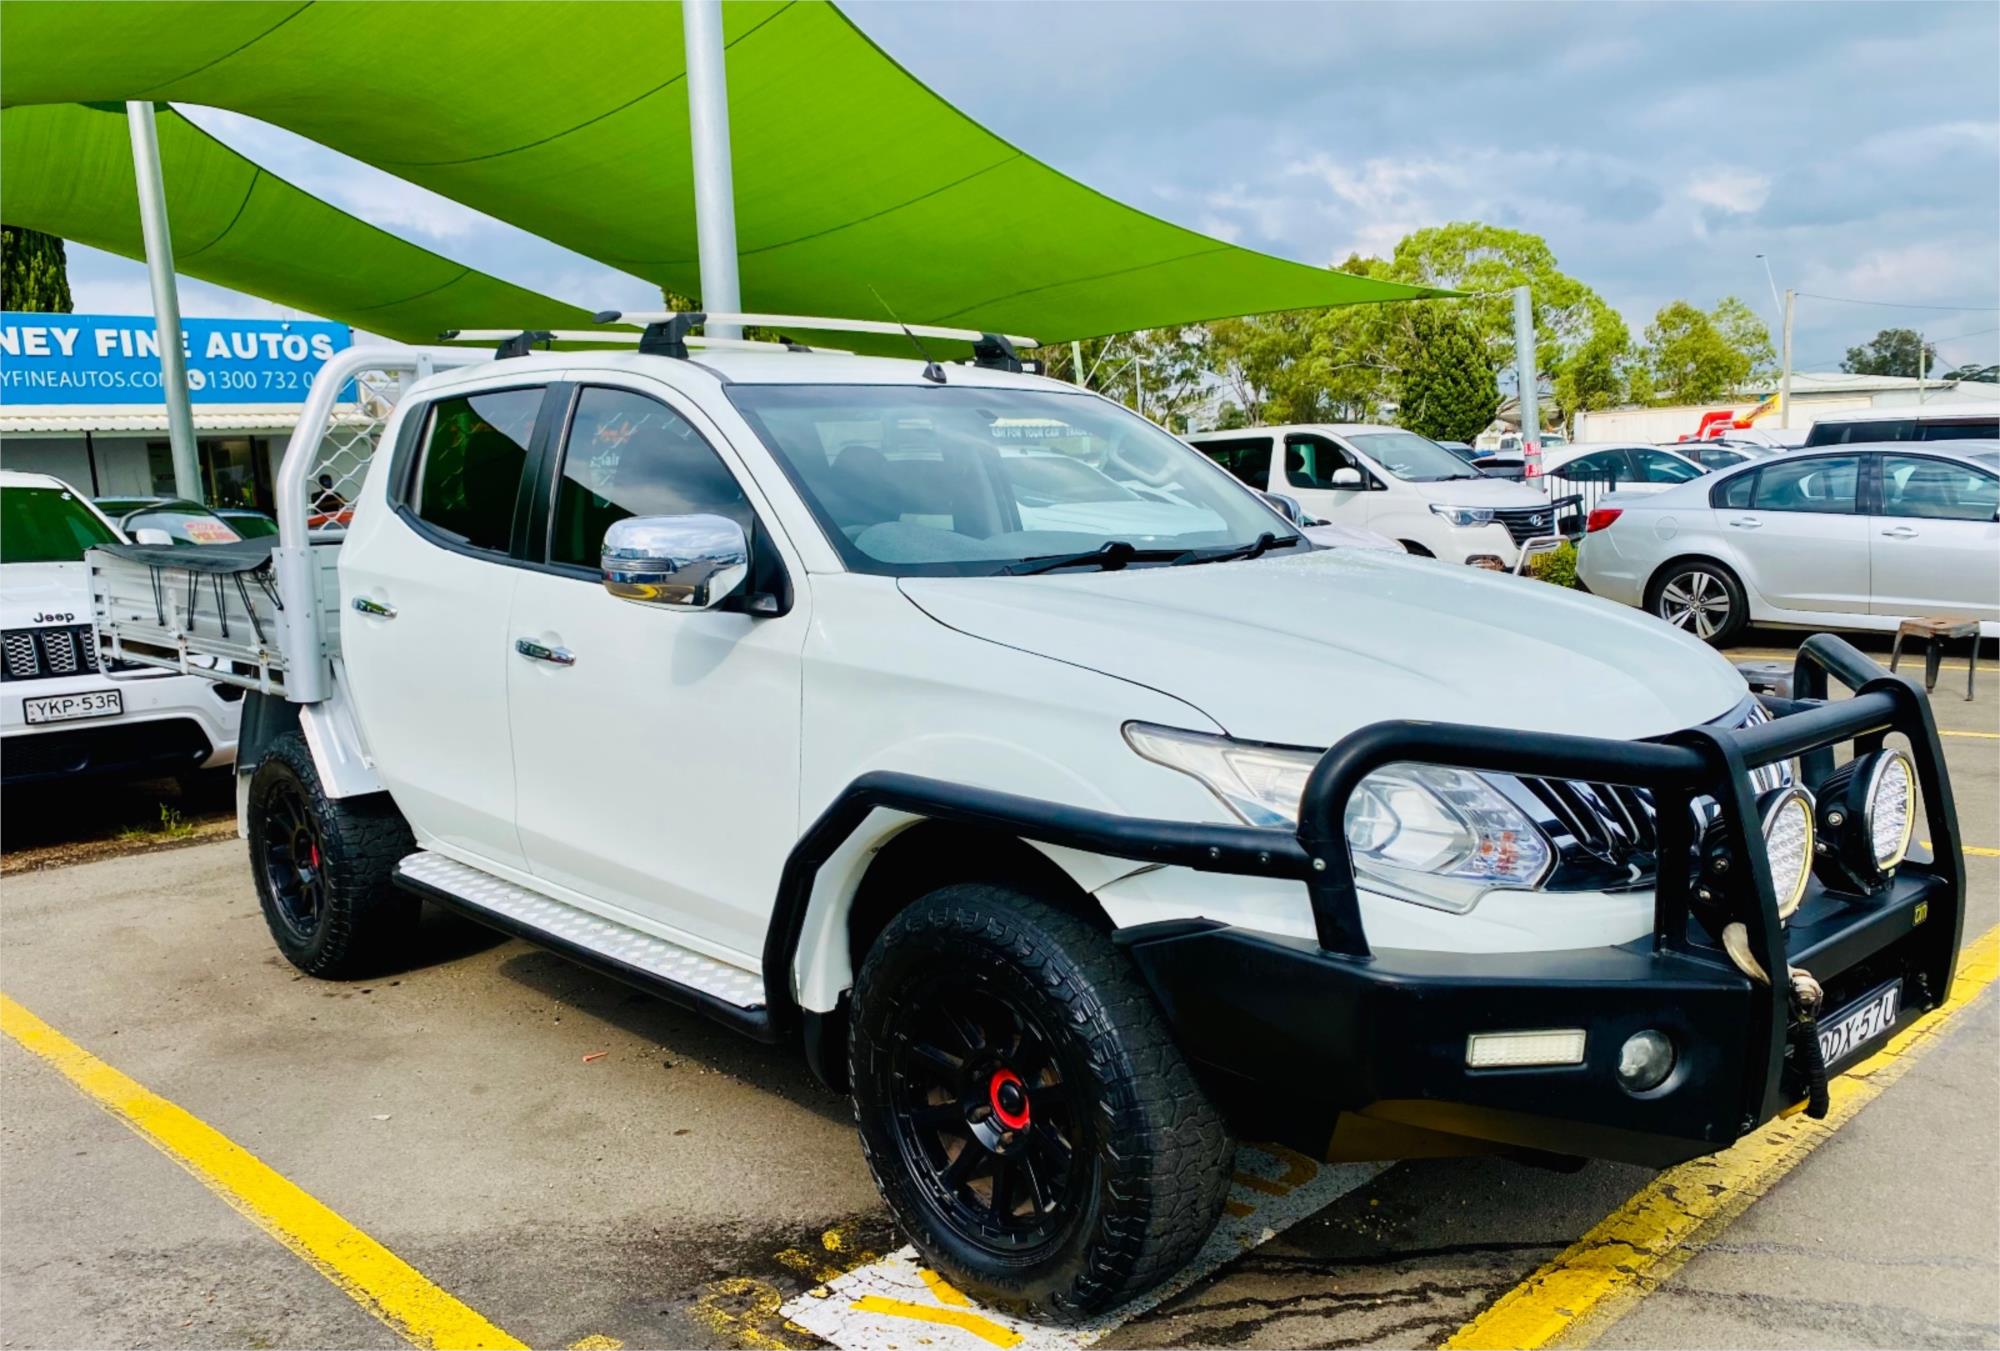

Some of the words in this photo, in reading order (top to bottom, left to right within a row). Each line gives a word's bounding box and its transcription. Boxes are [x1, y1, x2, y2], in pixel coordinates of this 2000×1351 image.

[206, 331, 334, 361] AUTOS
[0, 371, 164, 388] YFINEAUTOS.CO
[207, 371, 257, 389] 1300
[262, 371, 298, 389] 732
[33, 612, 75, 623] Jeep
